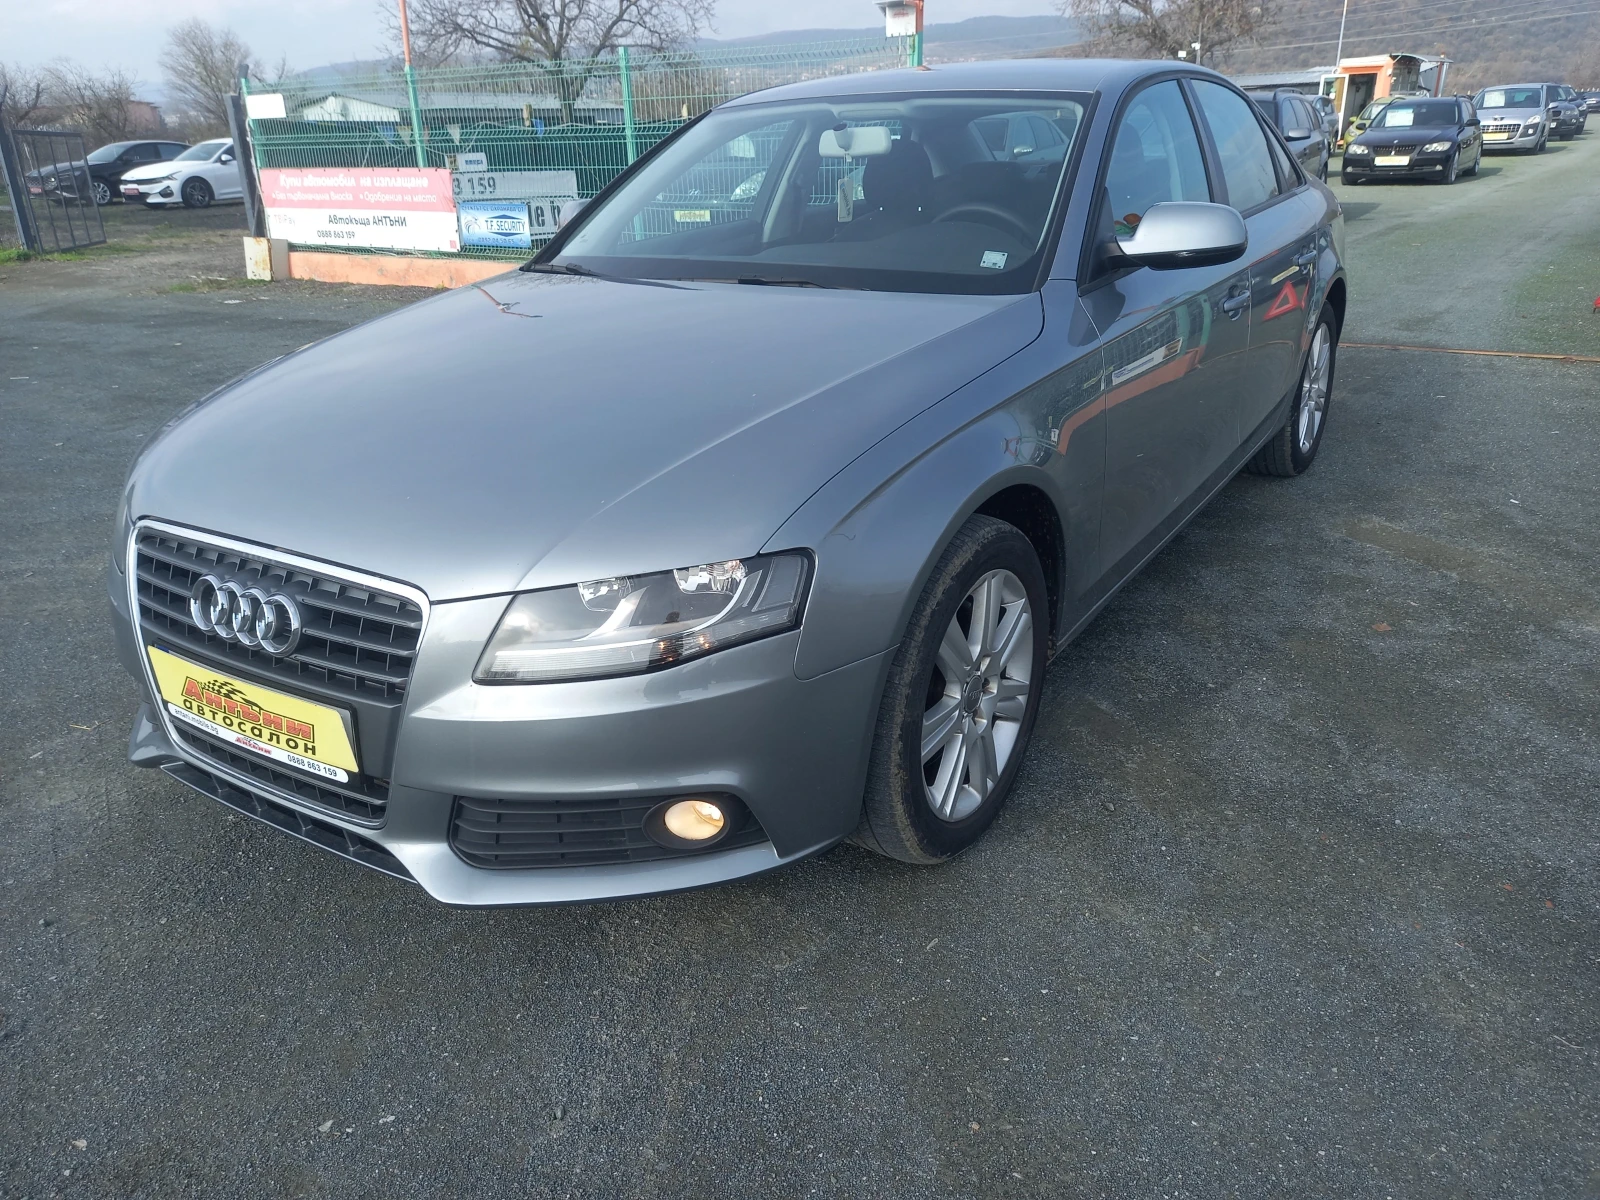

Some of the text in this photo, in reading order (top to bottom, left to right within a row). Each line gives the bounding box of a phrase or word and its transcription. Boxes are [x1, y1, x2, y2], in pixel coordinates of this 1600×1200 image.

[280, 173, 429, 189] Купи автомобил на изплащане
[468, 176, 496, 194] 159
[328, 214, 407, 227] Автокъща АНТЪНИ
[496, 220, 526, 232] SECURITY
[317, 230, 356, 239] 0888 863 159
[183, 698, 316, 755] автосалон
[287, 754, 338, 777] 0888 863 159
